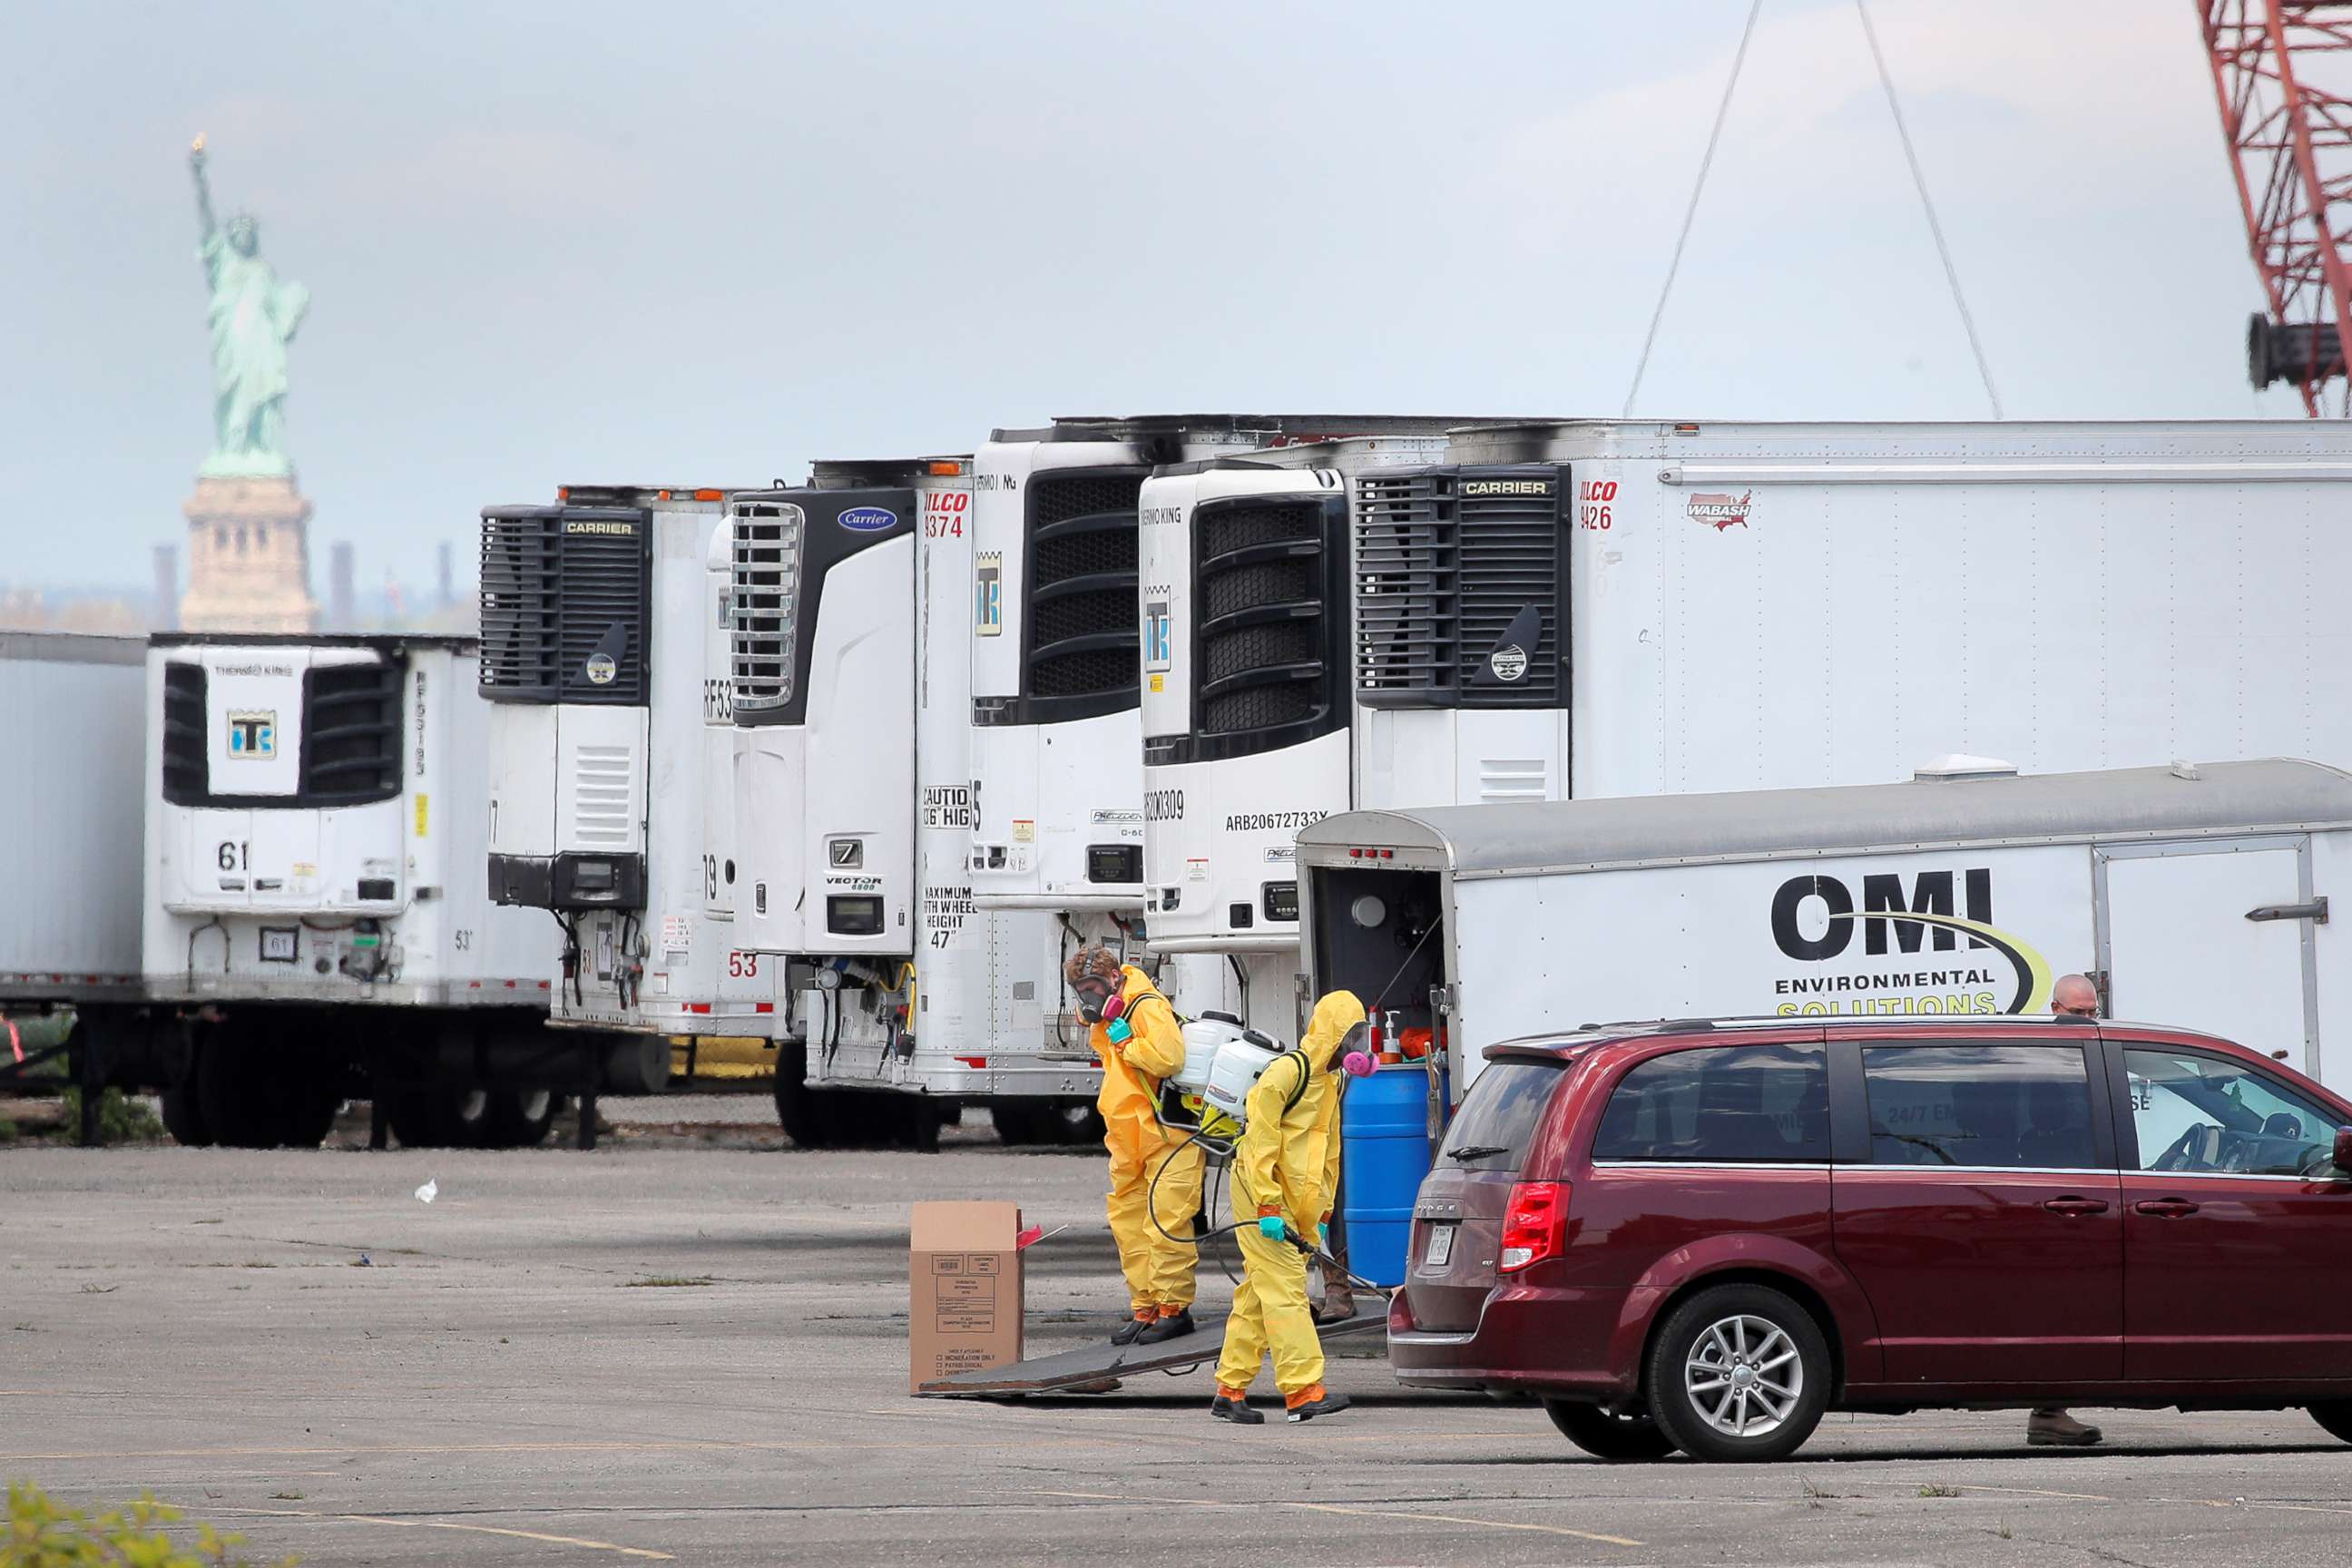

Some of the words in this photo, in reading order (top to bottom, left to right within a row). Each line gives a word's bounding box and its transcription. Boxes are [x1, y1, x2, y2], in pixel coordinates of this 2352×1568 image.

[1465, 482, 1546, 494] CARRIER
[1580, 481, 1618, 501] ILCO
[924, 493, 968, 512] ILCO
[1687, 505, 1751, 516] WABASH
[845, 513, 889, 524] Carrier
[1161, 506, 1181, 524] KING
[567, 522, 632, 534] CARRIER
[924, 789, 968, 806] CAUTIO
[219, 842, 247, 870] 61
[940, 900, 978, 914] WHEEL
[1770, 867, 1994, 961] OMI
[271, 937, 287, 952] 61
[930, 930, 956, 949] 47"
[729, 951, 757, 977] 53
[1775, 968, 1995, 995] ENVIRONMENTAL
